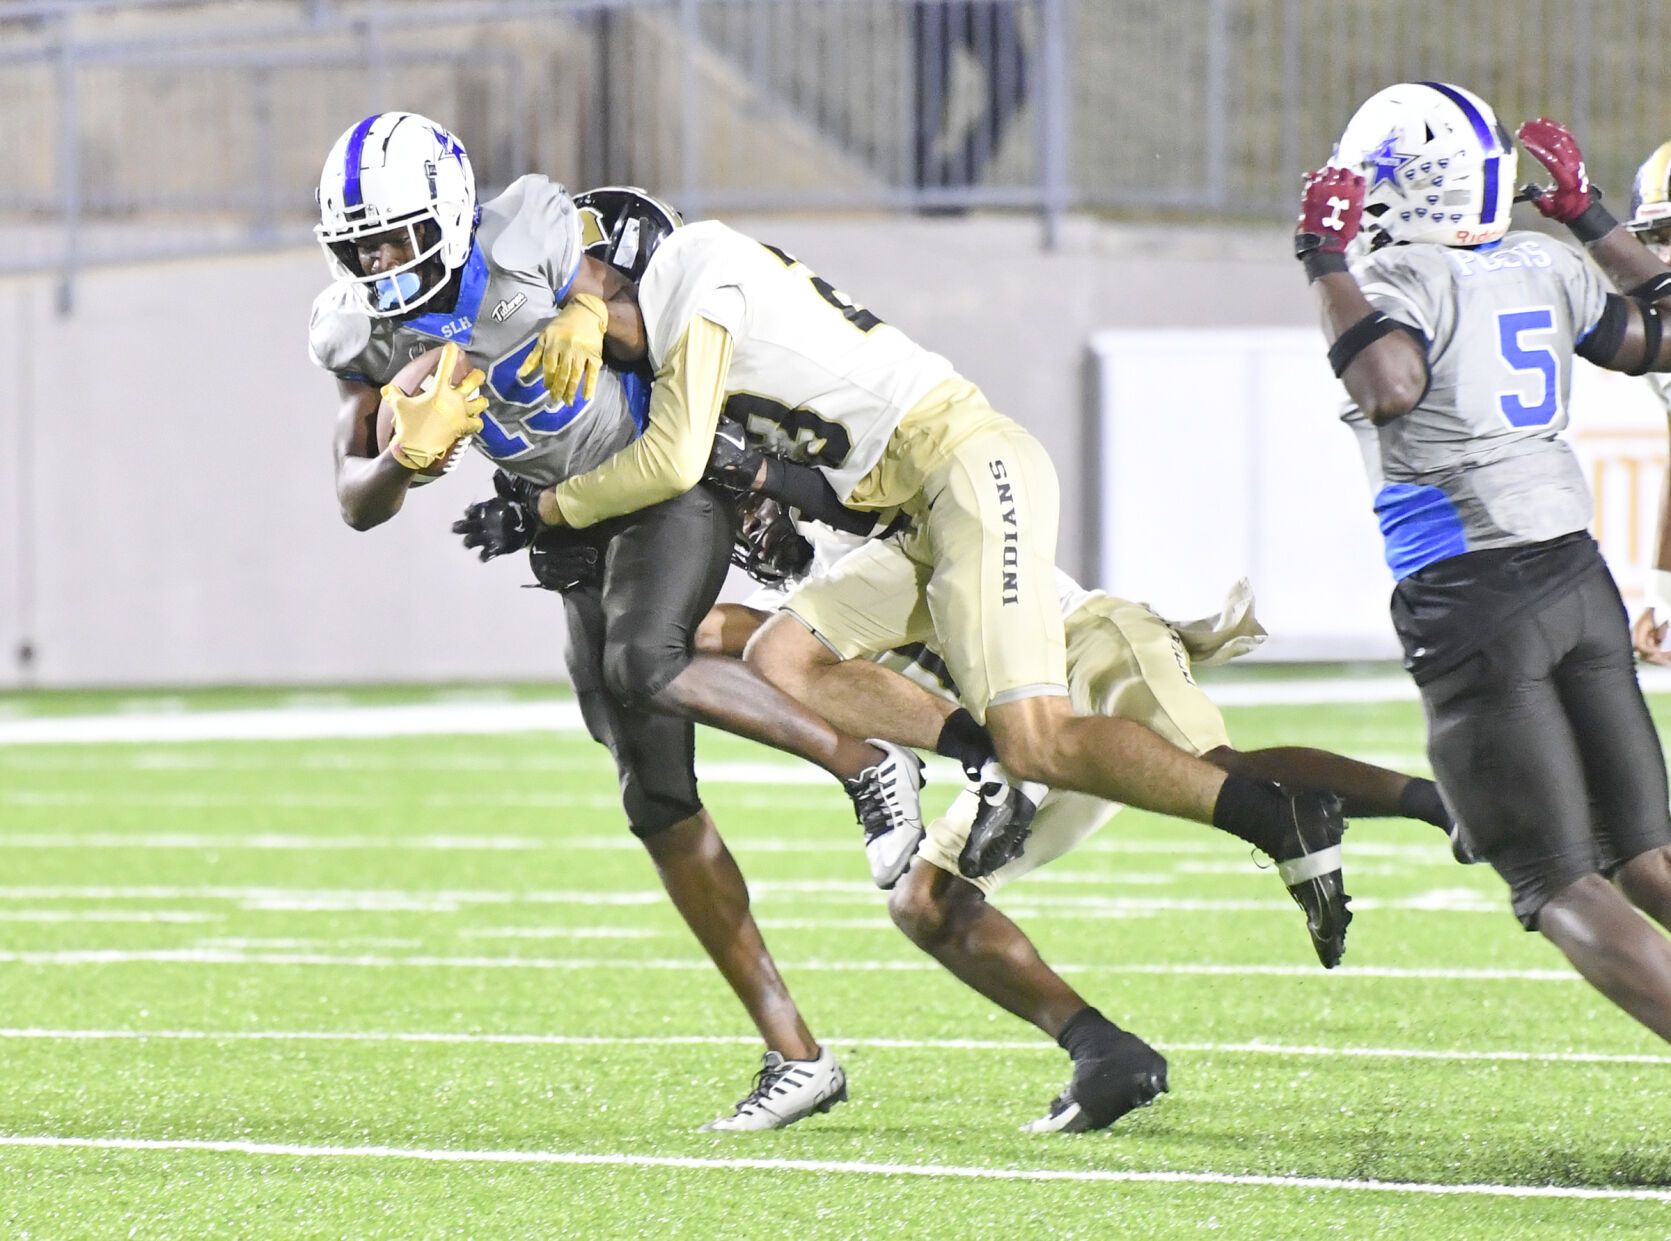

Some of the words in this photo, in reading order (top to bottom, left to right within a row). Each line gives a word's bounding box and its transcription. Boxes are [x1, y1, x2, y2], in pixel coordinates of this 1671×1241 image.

[441, 316, 472, 338] SLH
[1498, 306, 1560, 431] 5
[989, 460, 1019, 607] INDIANS
